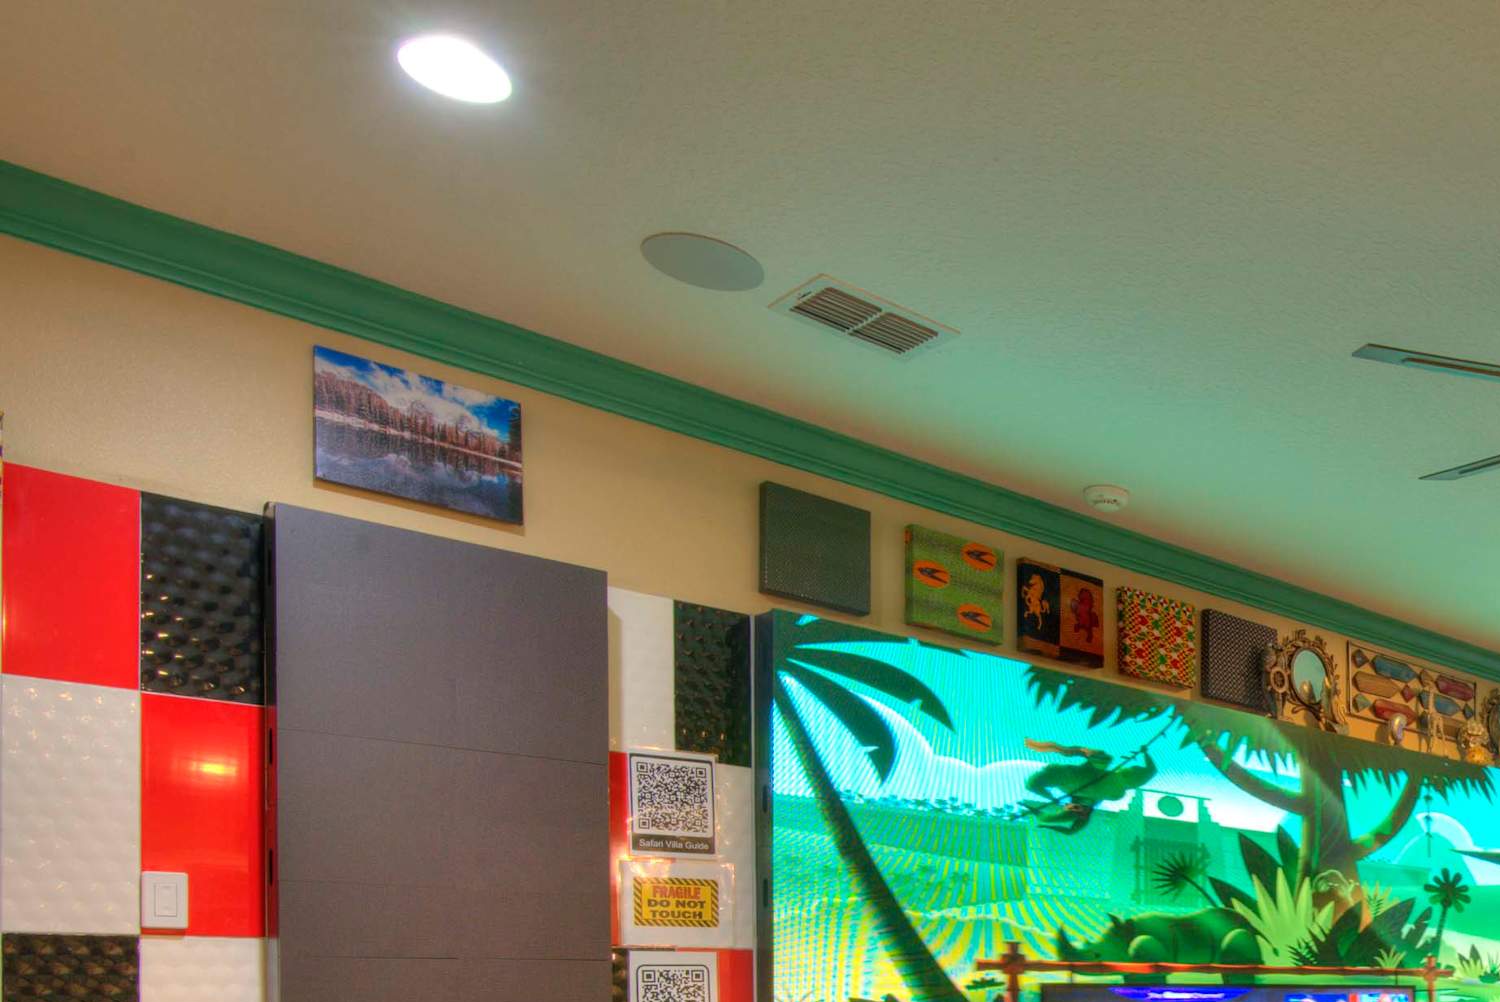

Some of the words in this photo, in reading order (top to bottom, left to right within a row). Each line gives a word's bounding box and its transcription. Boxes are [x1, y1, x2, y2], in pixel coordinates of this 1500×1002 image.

[639, 839, 664, 848] Safari
[666, 840, 684, 848] Villa
[685, 841, 710, 850] Guide
[652, 885, 702, 899] FRAGILE
[648, 899, 671, 908] DO
[675, 900, 706, 909] NOT
[650, 910, 703, 919] TOUCH
